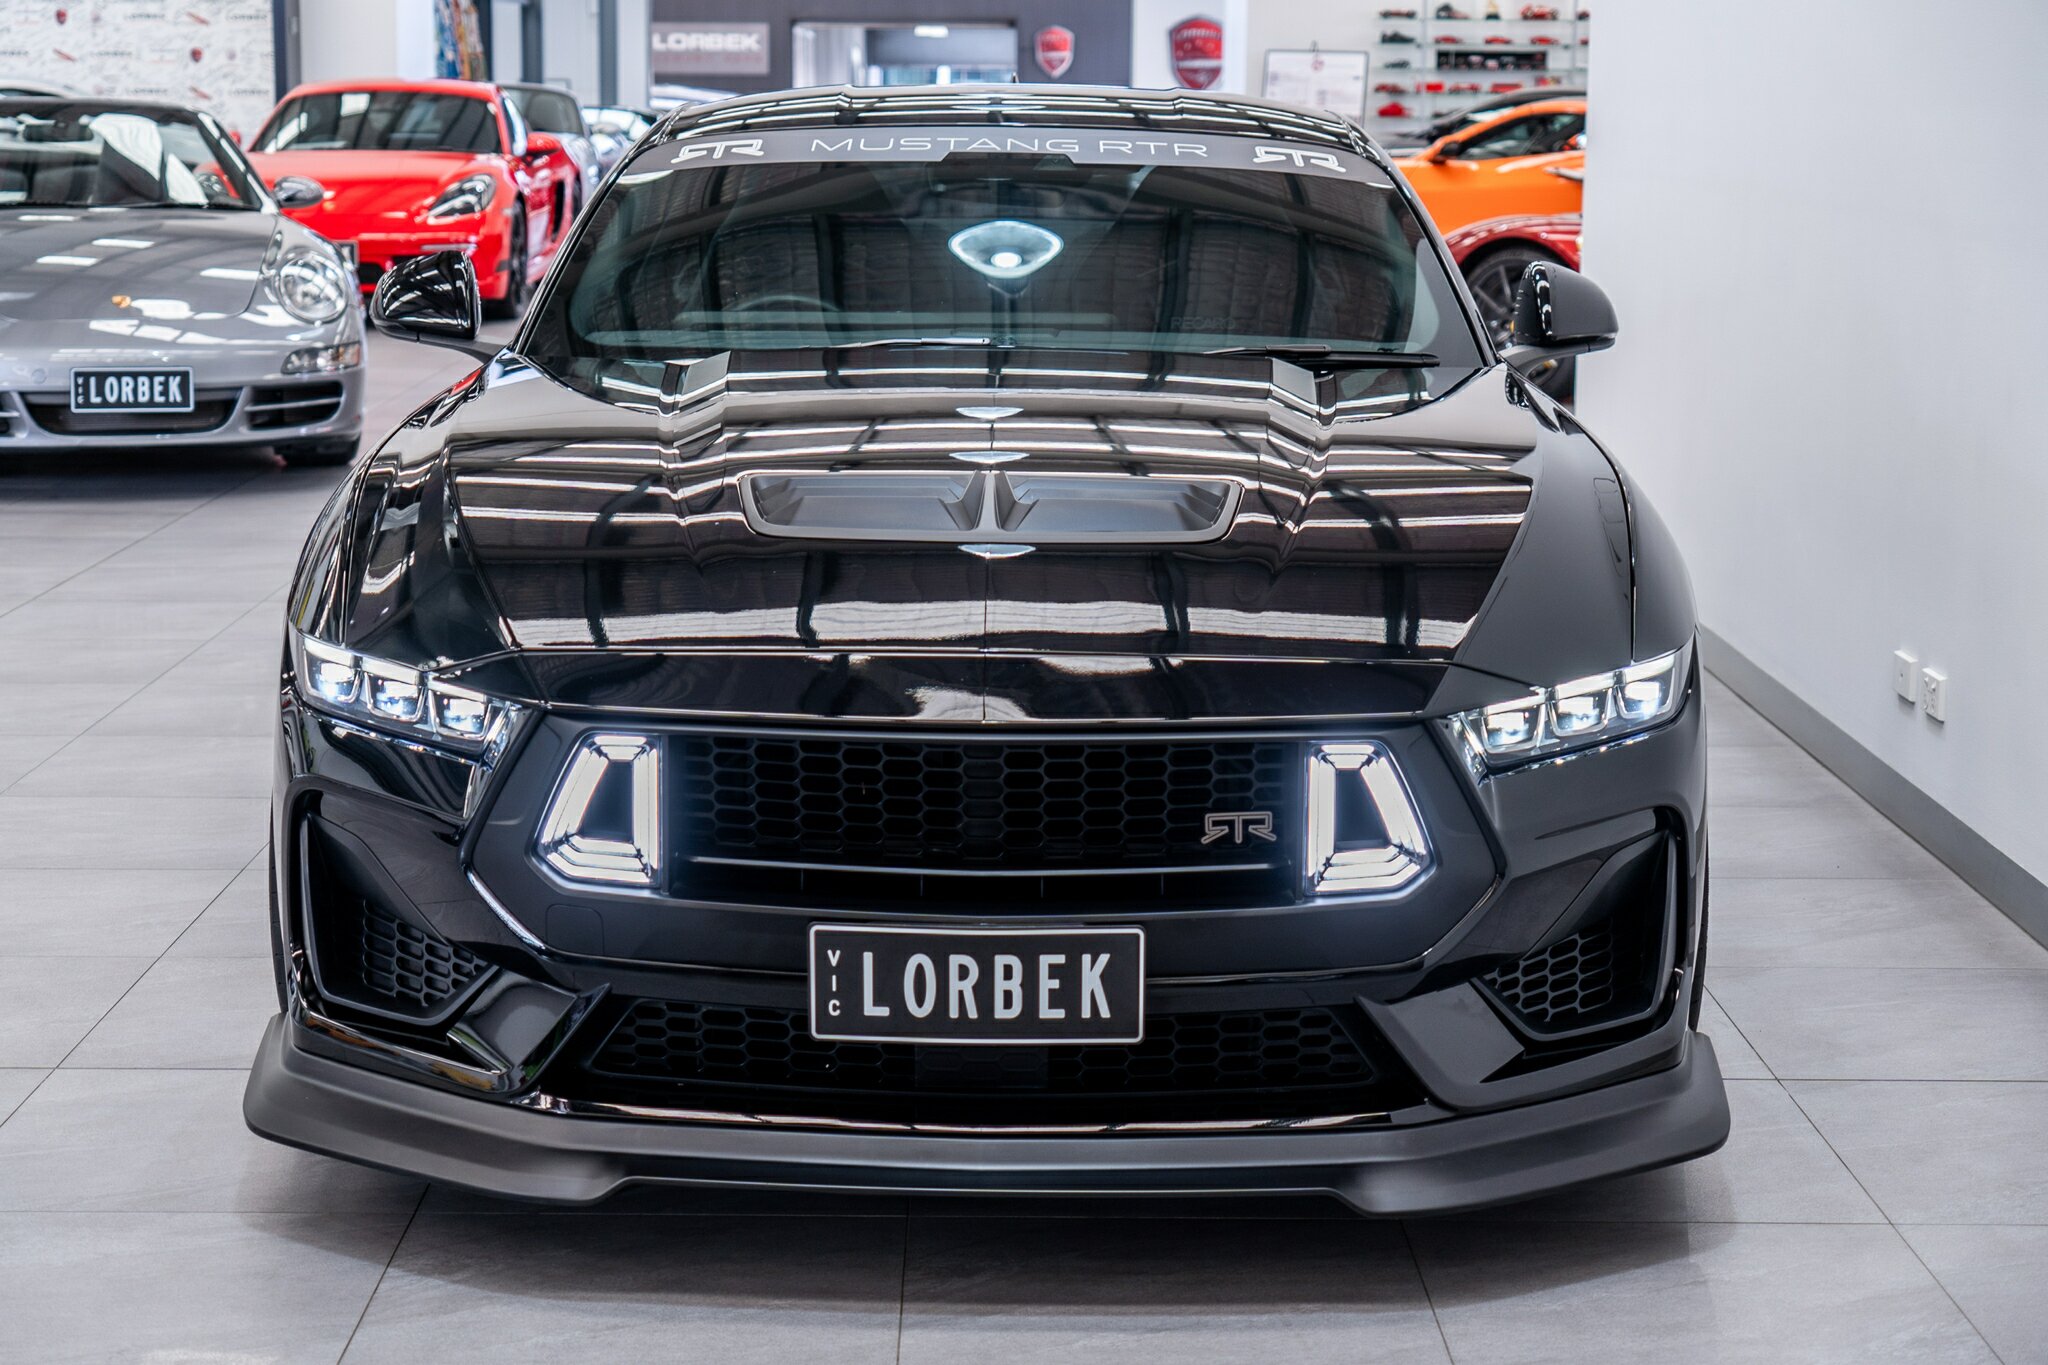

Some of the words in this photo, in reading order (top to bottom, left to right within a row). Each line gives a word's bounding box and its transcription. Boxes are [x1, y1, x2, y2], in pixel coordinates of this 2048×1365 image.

[652, 32, 761, 51] LORBEK
[811, 137, 1079, 152] MUSTANG
[1099, 140, 1208, 157] RTR
[76, 376, 84, 404] VIC
[89, 375, 182, 403] LORBEK
[1201, 811, 1277, 844] RTR
[827, 949, 841, 1017] VIC
[863, 951, 1111, 1019] LORBEK
